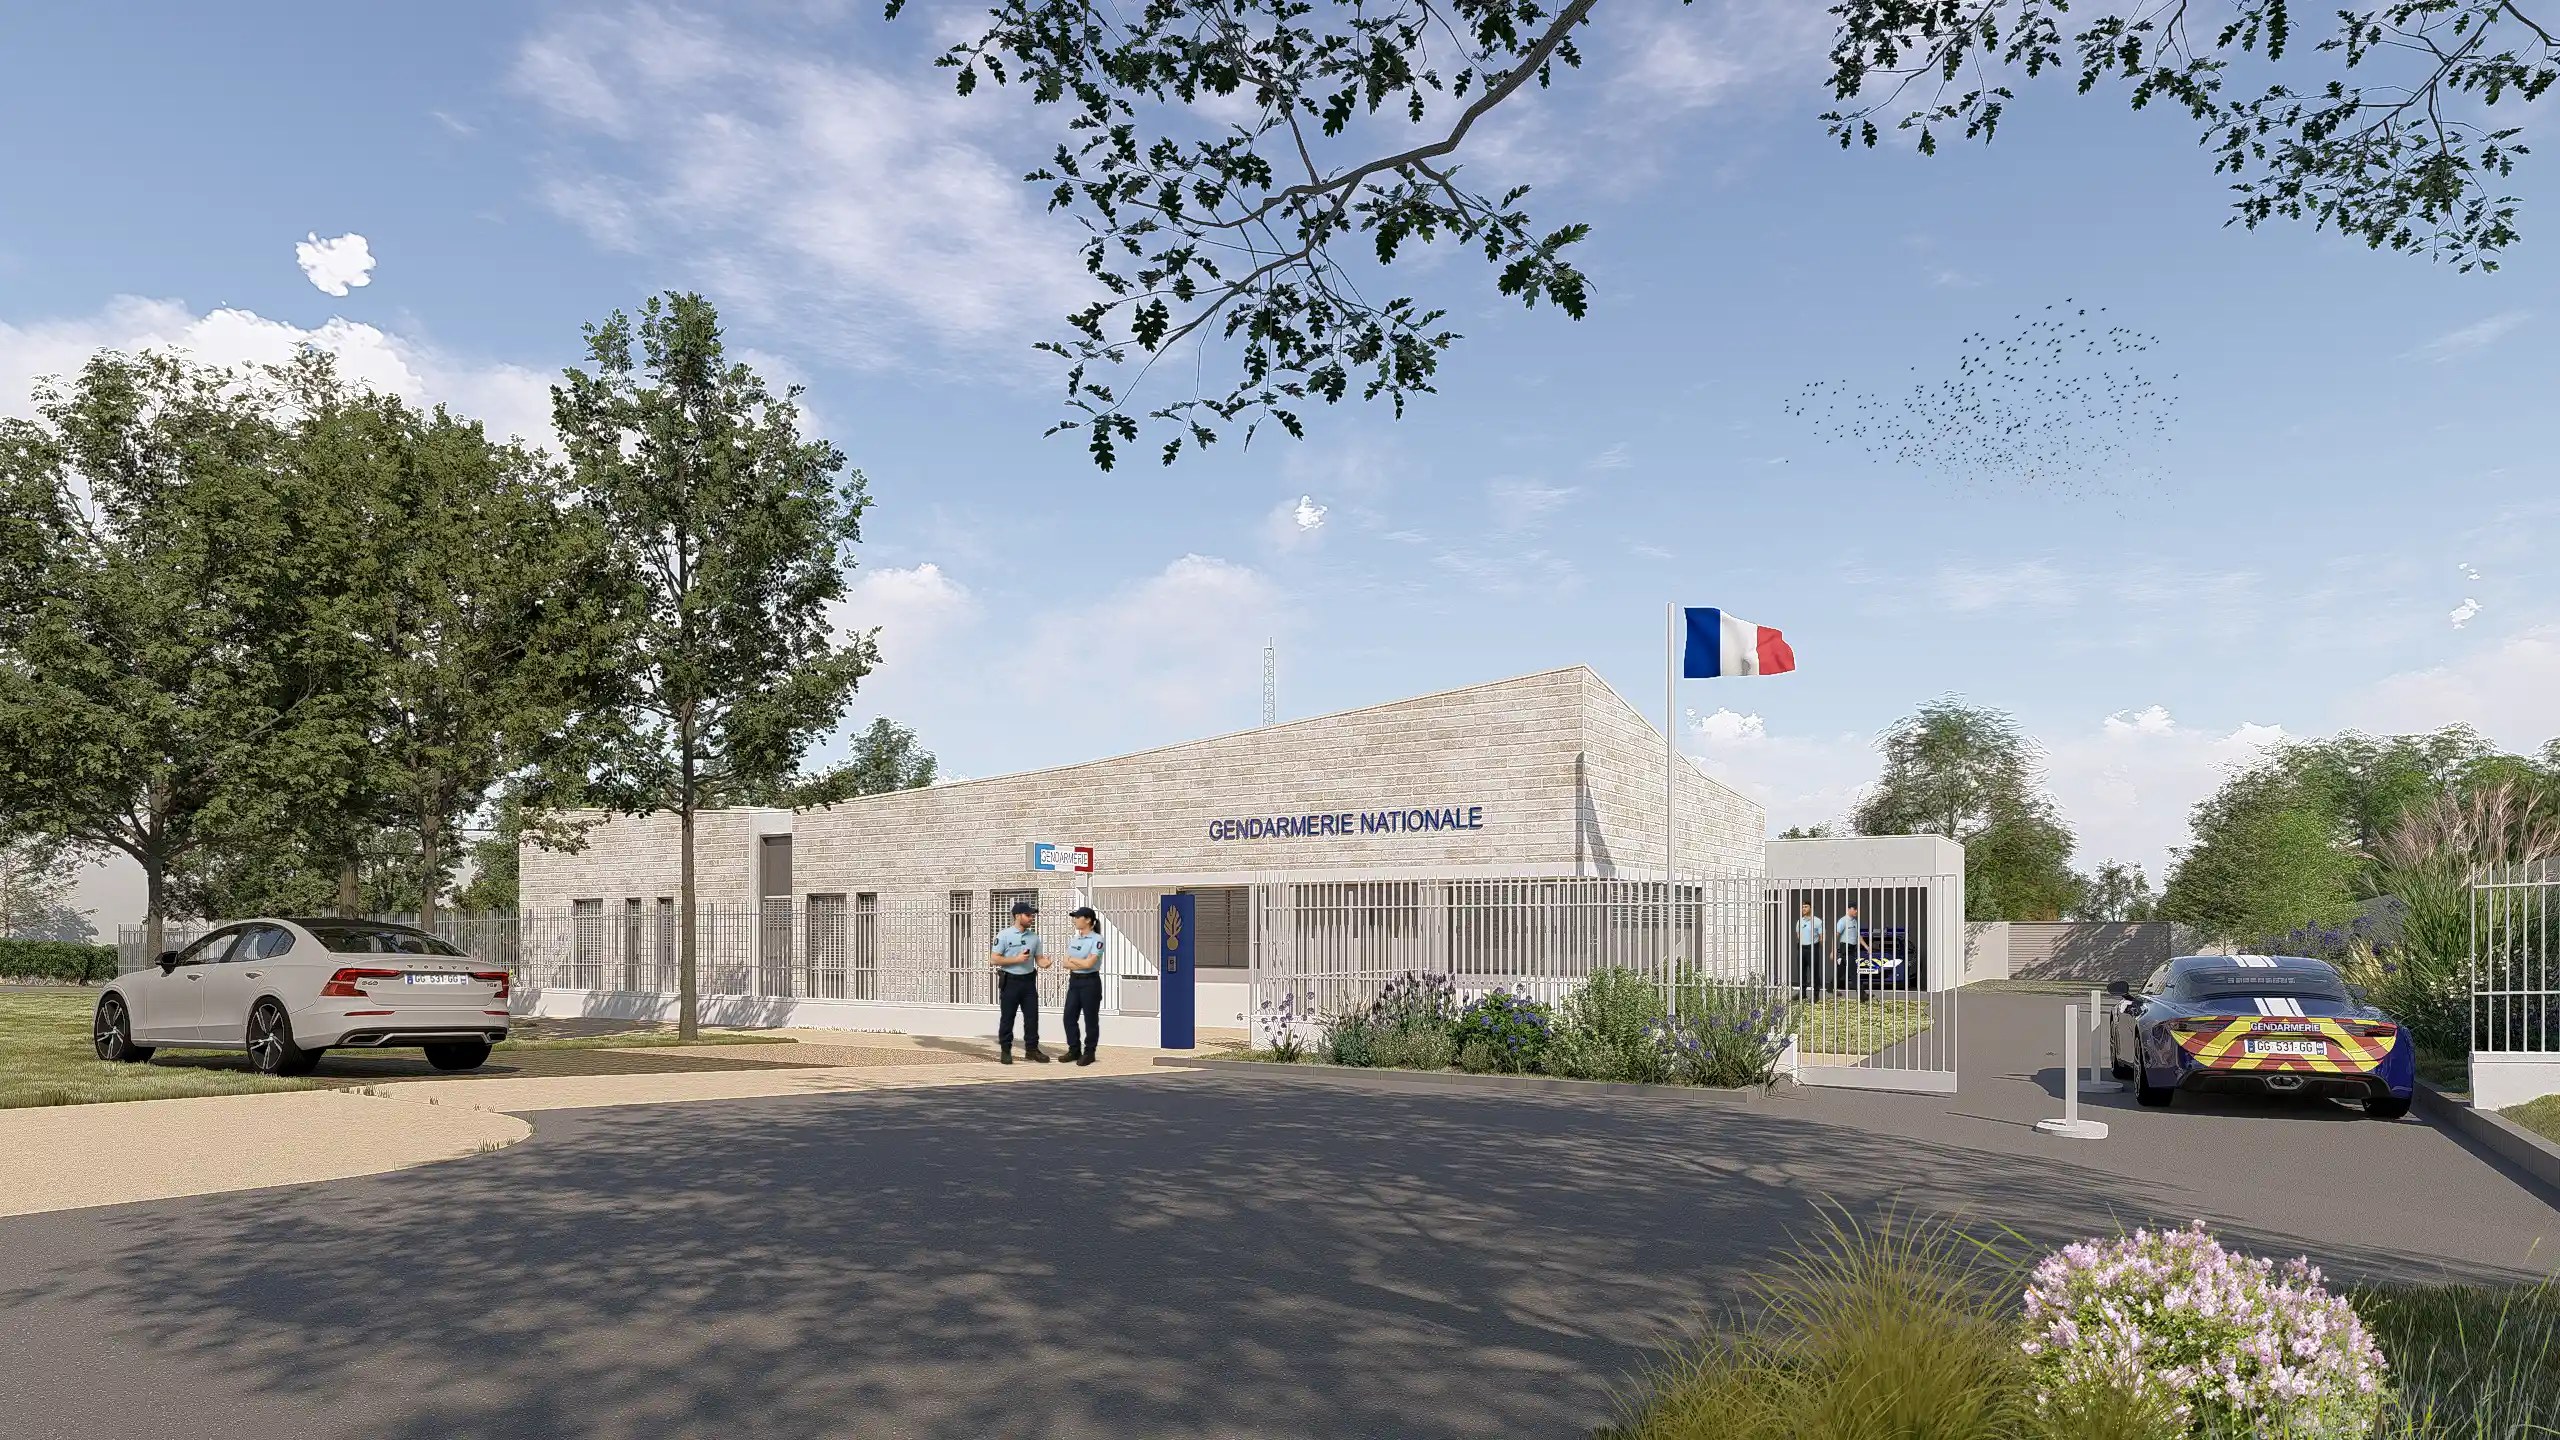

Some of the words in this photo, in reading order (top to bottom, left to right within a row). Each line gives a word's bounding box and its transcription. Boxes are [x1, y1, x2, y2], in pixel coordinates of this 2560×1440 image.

[1209, 813, 1355, 842] GENDARMERIE
[1360, 806, 1484, 835] NATIONALE
[1041, 850, 1088, 865] GENDARMERIE
[2250, 1022, 2320, 1032] GENDARMERIE
